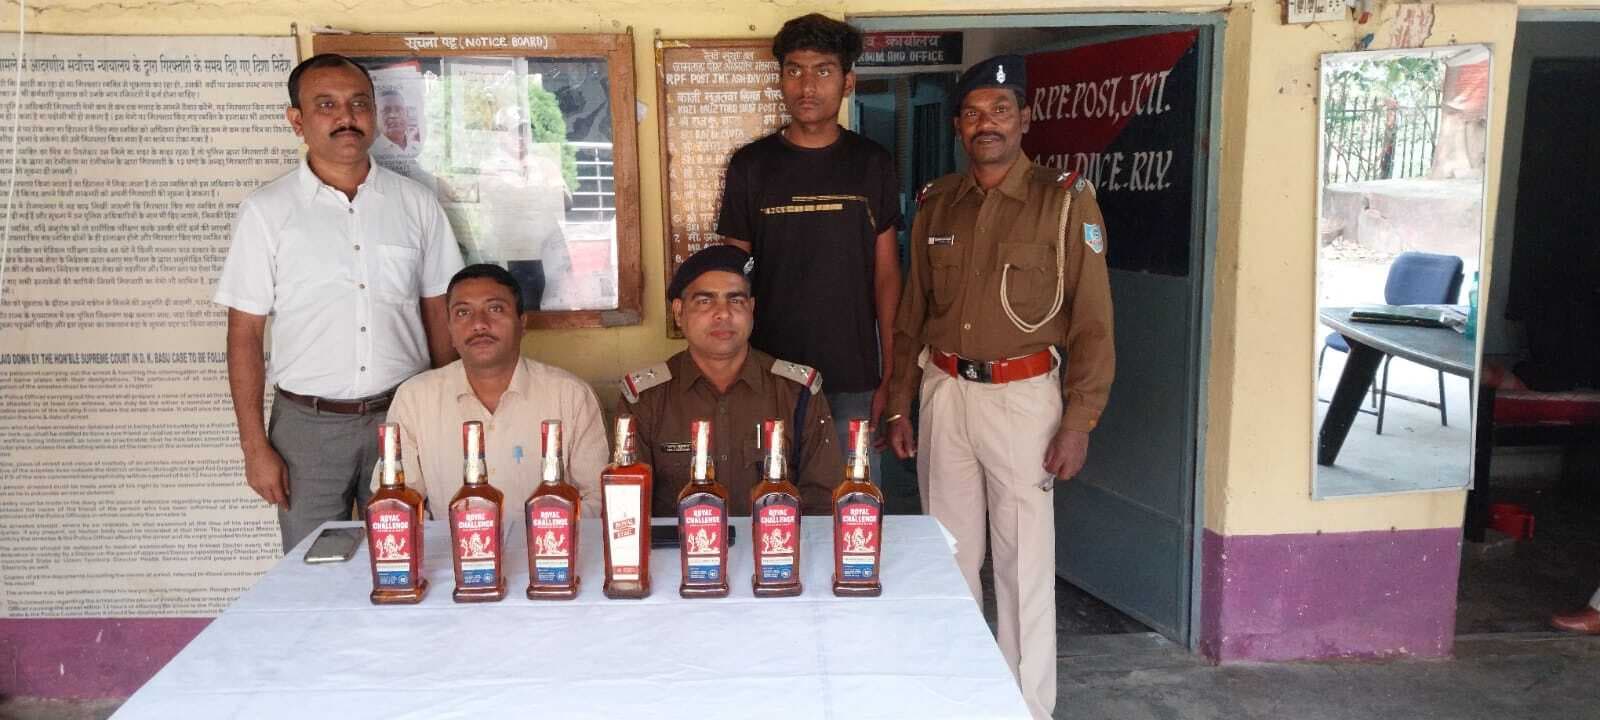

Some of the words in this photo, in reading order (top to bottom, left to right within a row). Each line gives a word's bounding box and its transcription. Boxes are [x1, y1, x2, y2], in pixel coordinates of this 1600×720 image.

[511, 36, 548, 49] BOARD)
[910, 50, 944, 61] OFFICE
[132, 54, 142, 72] के
[194, 55, 203, 72] के
[204, 60, 222, 73] समय
[253, 54, 270, 74] दिशा
[666, 73, 686, 86] RPF
[690, 73, 709, 84] POST
[758, 103, 776, 113] POST
[12, 354, 31, 364] DOWN
[32, 354, 39, 364] BY
[41, 354, 54, 364] THE
[81, 353, 110, 364] SUPREME
[110, 353, 130, 364] COURT
[132, 353, 138, 363] IN
[155, 353, 171, 363] BASU
[172, 353, 188, 363] CASE
[188, 353, 197, 363] TO
[198, 353, 207, 363] BE
